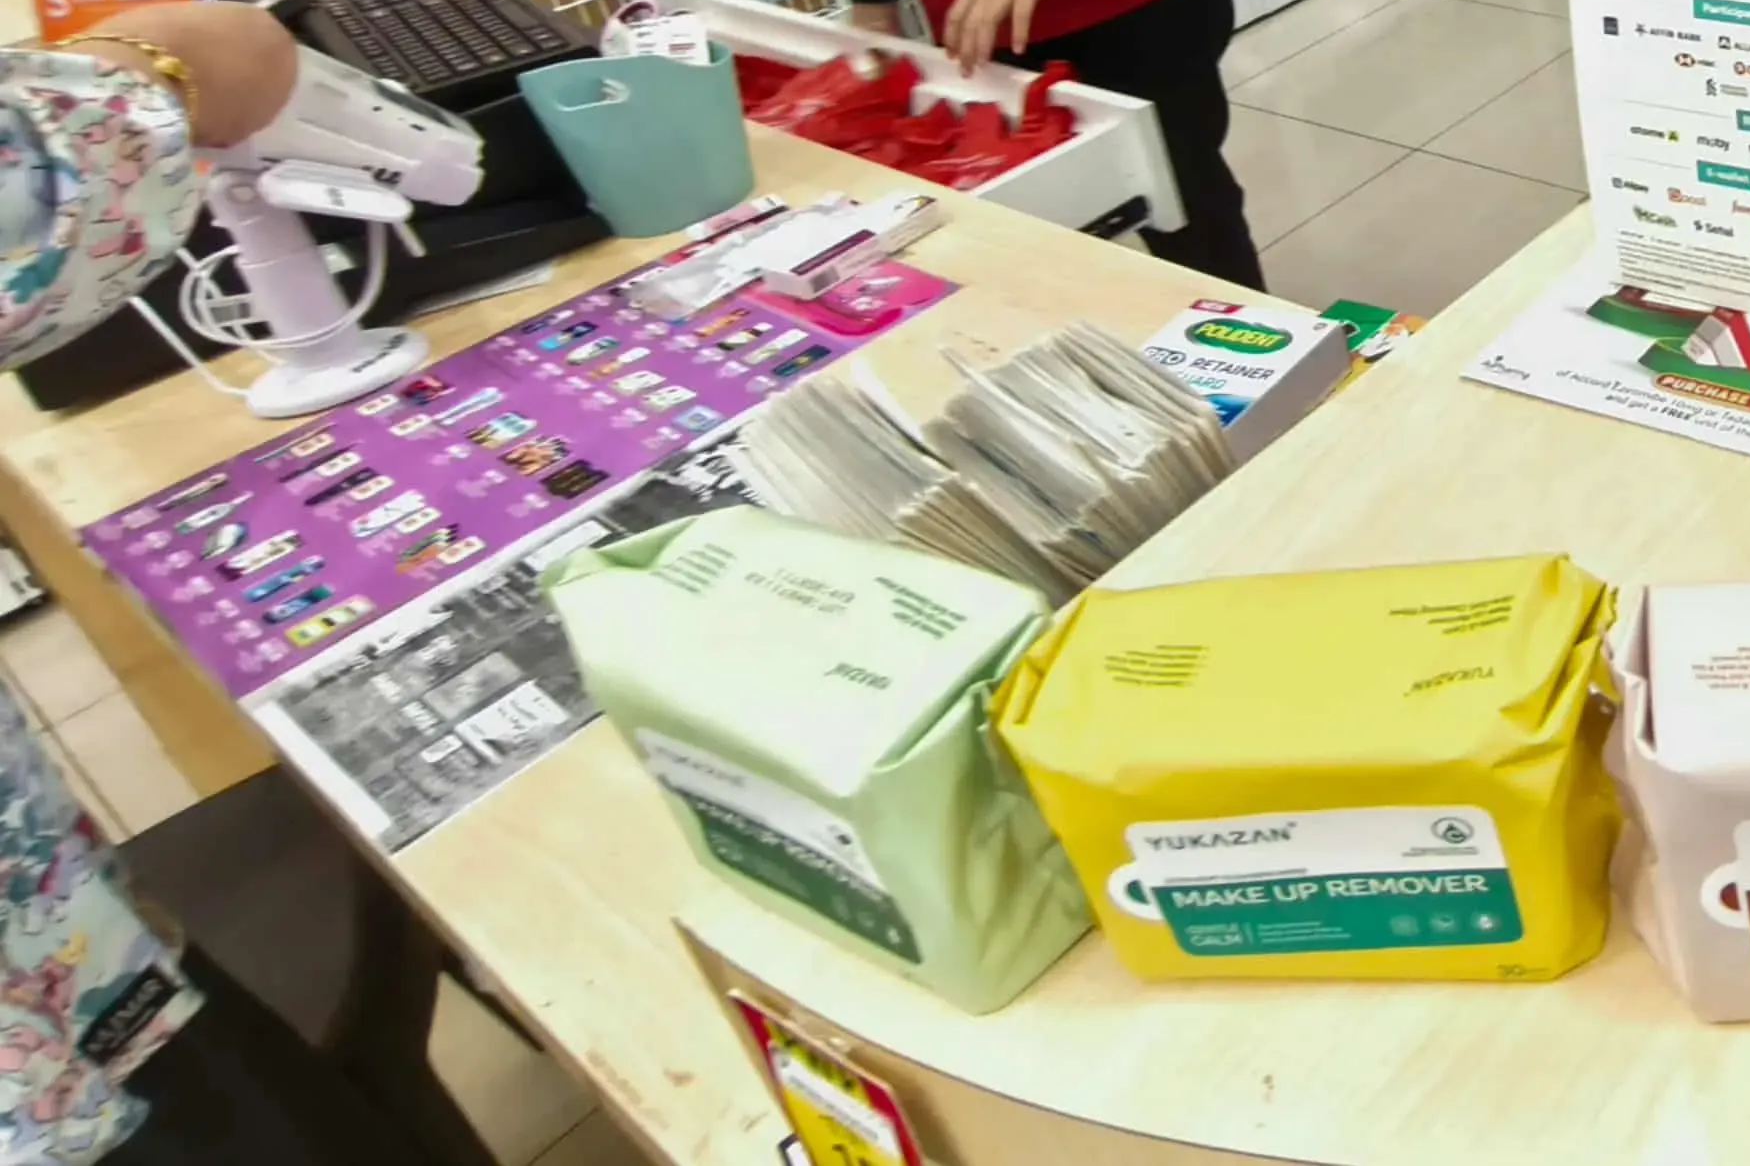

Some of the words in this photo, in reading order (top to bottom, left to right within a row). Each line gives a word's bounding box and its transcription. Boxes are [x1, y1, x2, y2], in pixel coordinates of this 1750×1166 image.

[1196, 323, 1285, 347] POLIDENT
[1190, 356, 1275, 380] RETAINER
[1660, 405, 1693, 421] FREE
[1145, 826, 1293, 851] YUKAZAN
[1170, 886, 1270, 909] MAKE
[1274, 881, 1320, 903] UP
[1325, 874, 1489, 898] REMOVER
